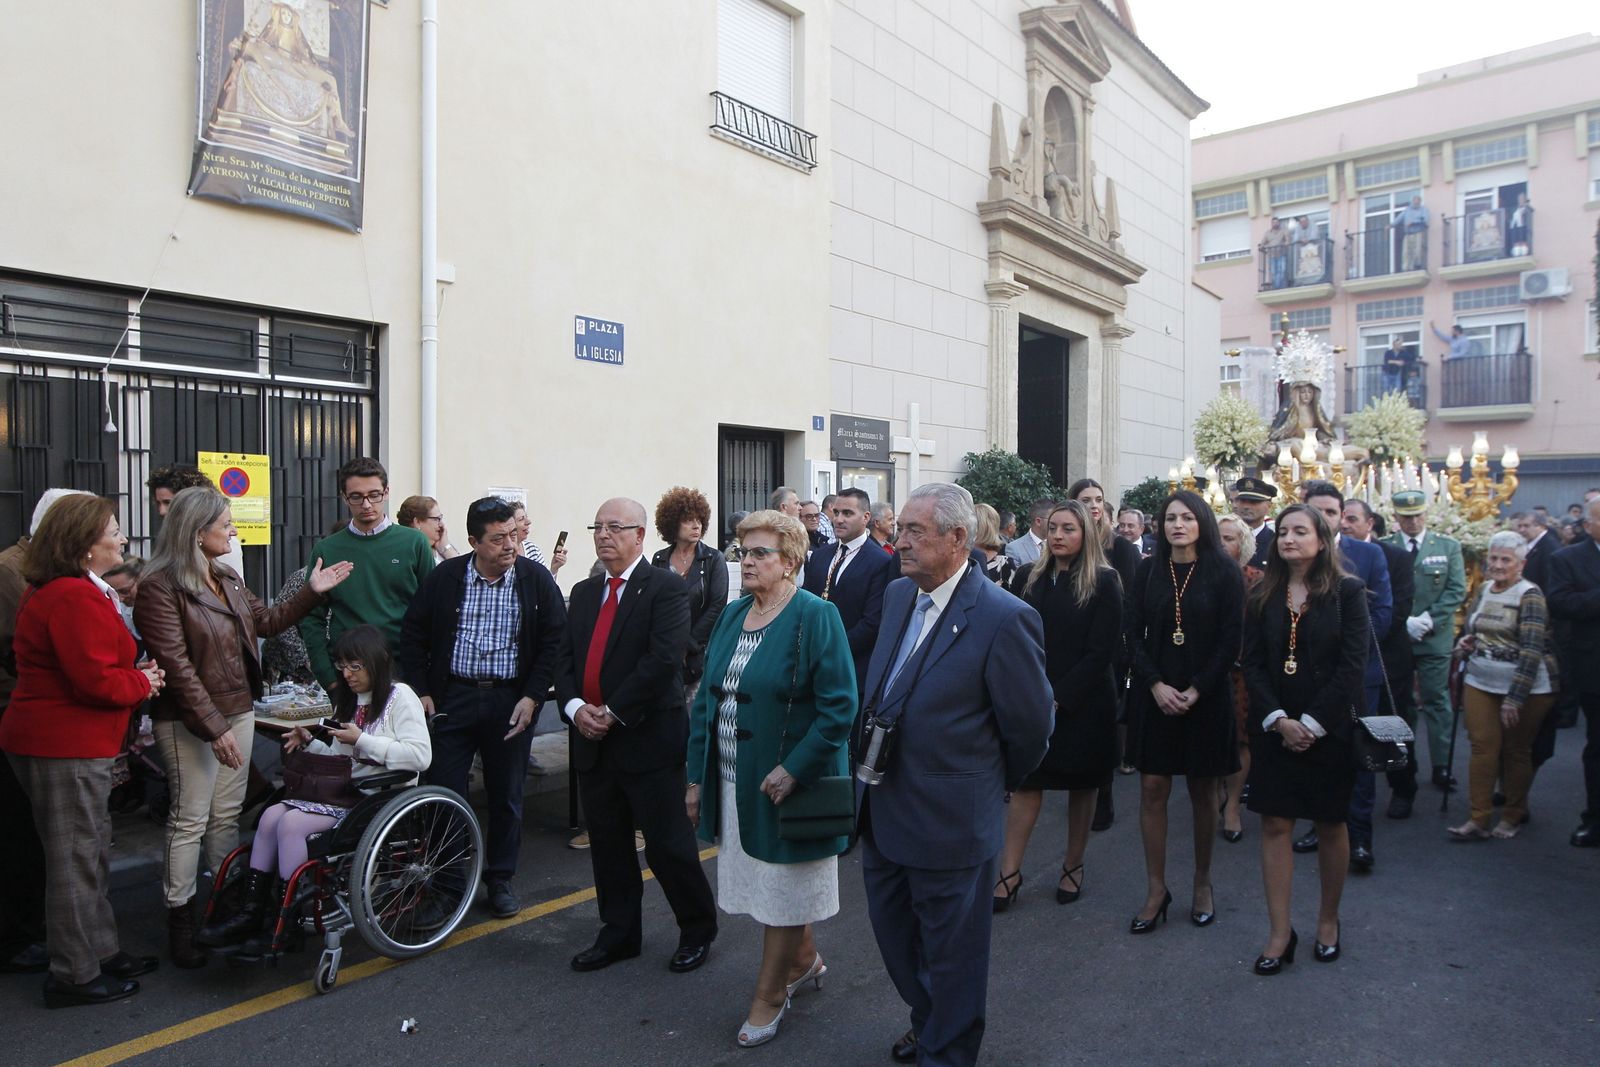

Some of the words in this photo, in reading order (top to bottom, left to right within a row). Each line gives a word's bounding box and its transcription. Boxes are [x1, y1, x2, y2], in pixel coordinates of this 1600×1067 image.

[202, 151, 228, 164] Ntra.
[229, 156, 248, 168] Sra.
[265, 164, 288, 178] Stma.
[288, 170, 299, 180] de
[300, 173, 311, 185] las
[312, 177, 351, 196] Angustias
[202, 164, 250, 181] PATRONA
[252, 173, 258, 183] Y
[260, 176, 307, 198] ALCALDESA
[309, 190, 350, 208] PERPETUA
[246, 184, 280, 201] VIATOR
[280, 194, 316, 211] (Almería)
[589, 321, 618, 334] PLAZA
[576, 344, 588, 358] LA
[591, 346, 622, 362] IGLESIA
